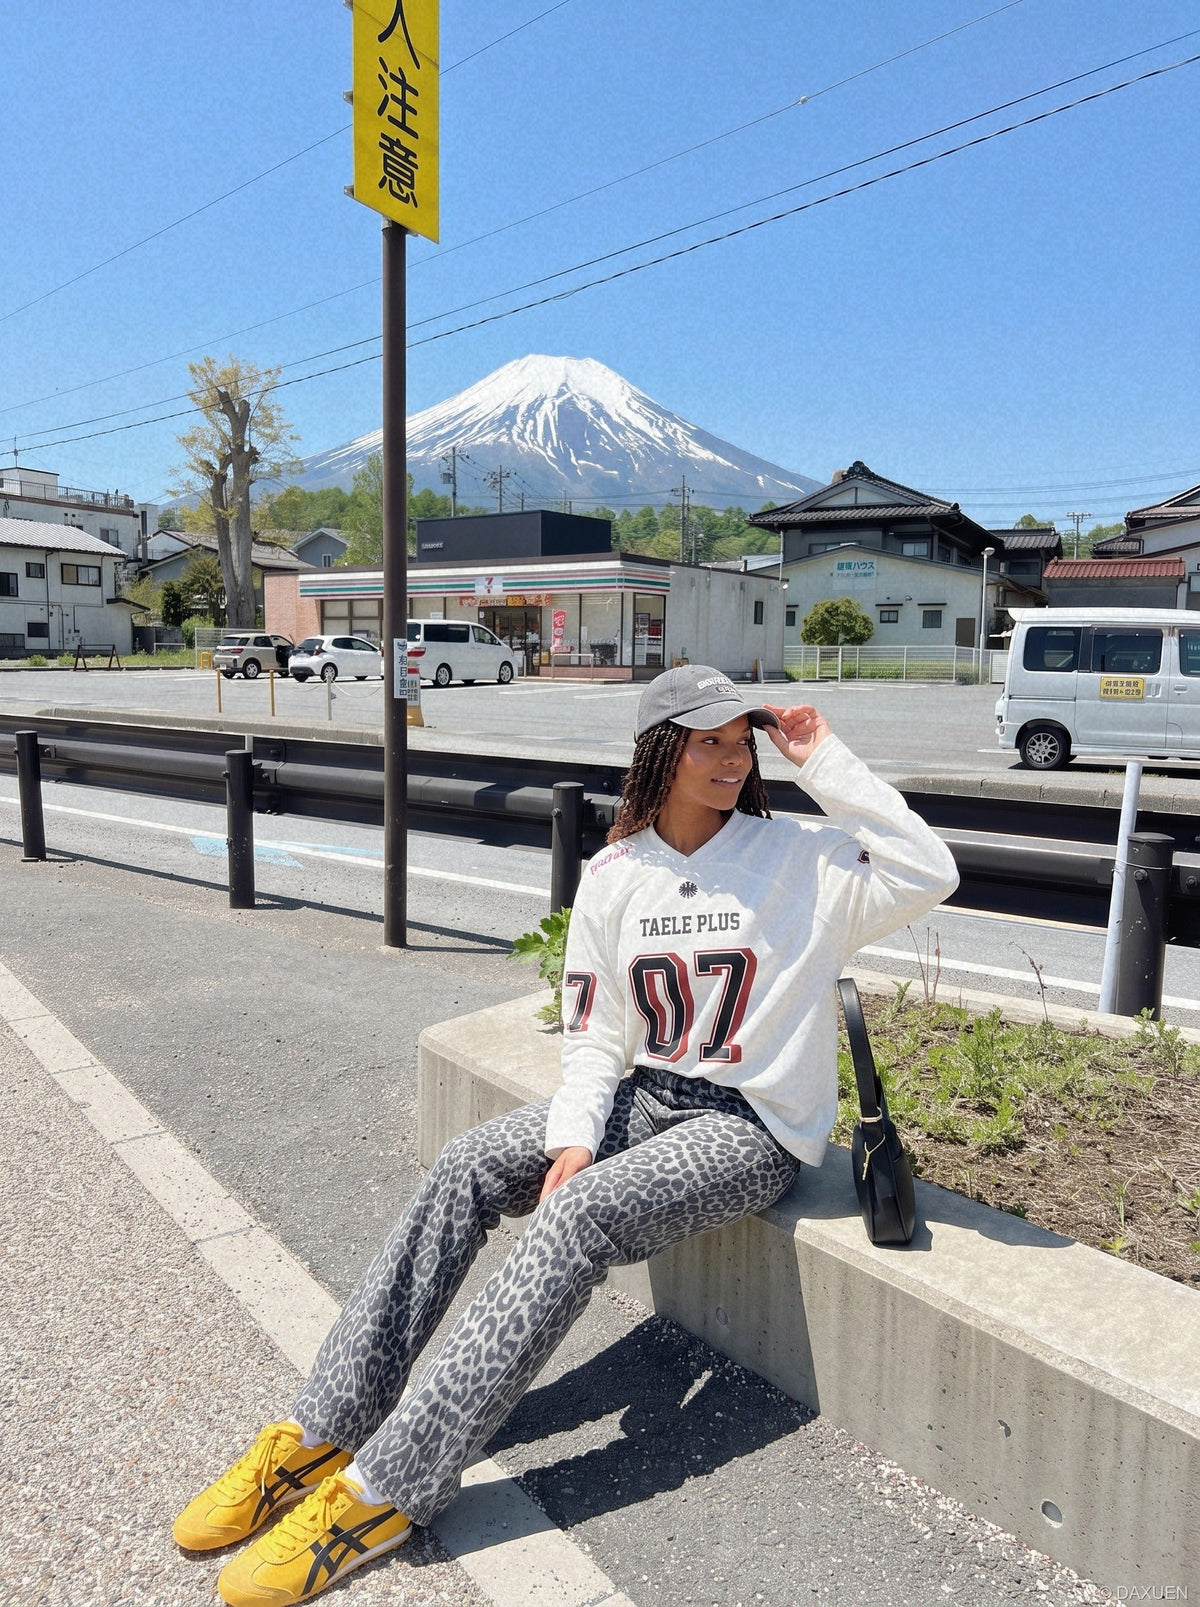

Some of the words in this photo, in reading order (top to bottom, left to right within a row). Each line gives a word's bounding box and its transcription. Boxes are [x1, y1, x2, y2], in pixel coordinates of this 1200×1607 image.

[640, 915, 692, 937] TAELE
[697, 912, 740, 932] PLUS
[565, 971, 597, 1033] 7
[628, 947, 757, 1064] 07
